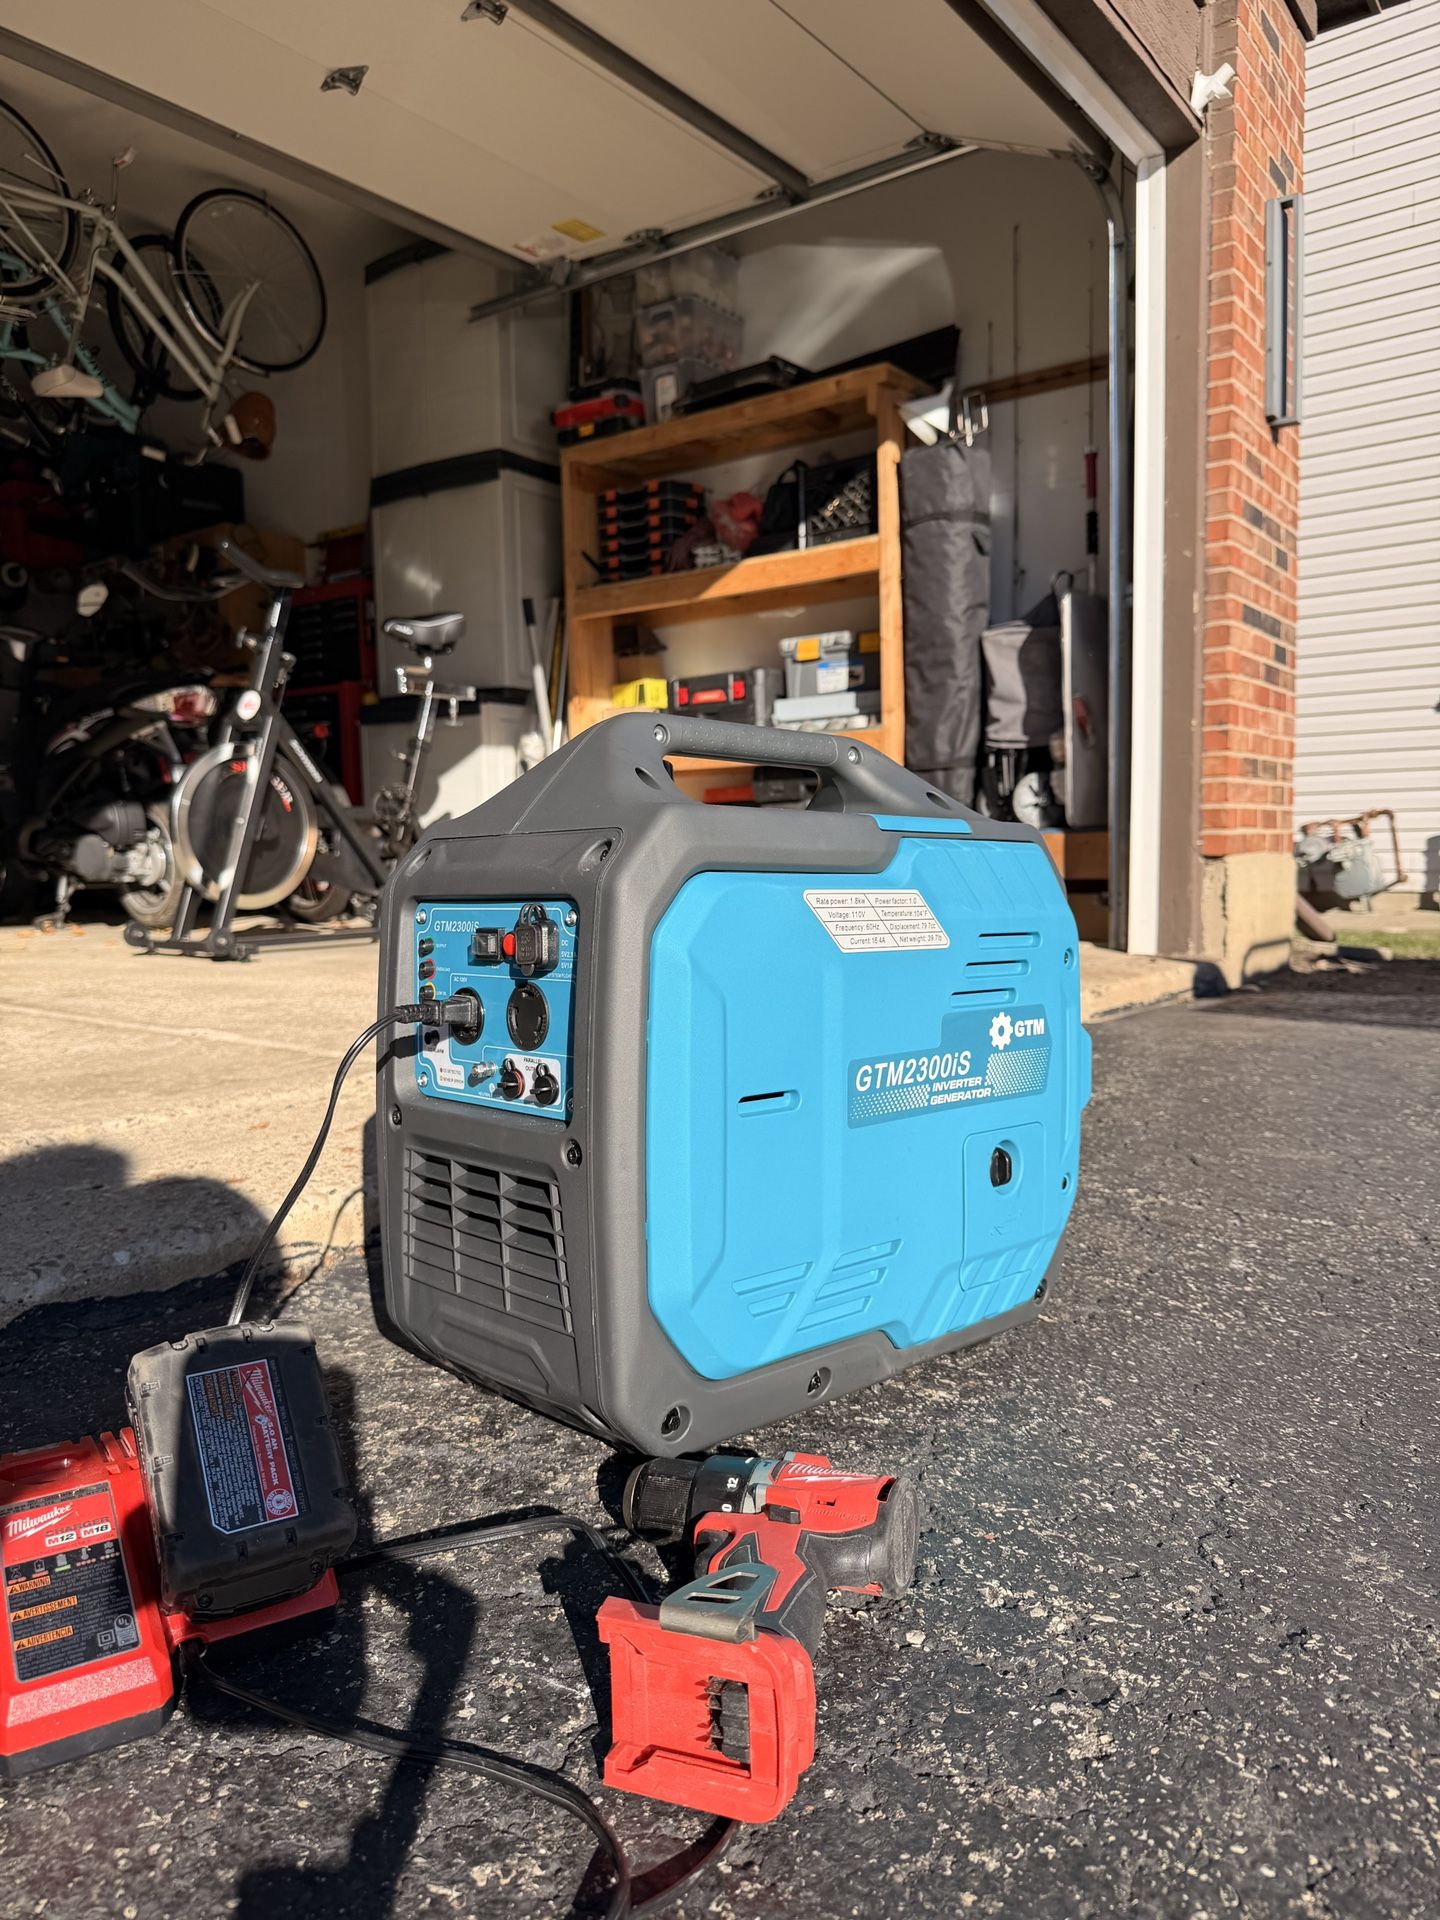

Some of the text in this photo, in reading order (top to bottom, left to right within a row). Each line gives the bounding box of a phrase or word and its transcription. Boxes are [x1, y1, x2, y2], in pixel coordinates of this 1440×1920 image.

[434, 921, 480, 933] GTM2300iS
[1014, 1018, 1045, 1038] GTM
[855, 1051, 971, 1092] GTM2300iS
[932, 1076, 982, 1092] INVERTER
[930, 1088, 991, 1105] GENERATOR
[247, 1367, 275, 1414] Milwaukee
[270, 1436, 278, 1449] AH
[268, 1461, 279, 1485] PACK
[726, 1477, 739, 1489] 12
[4, 1503, 72, 1537] Milwaukee
[47, 1532, 75, 1546] M12
[18, 1576, 50, 1592] WARNING
[23, 1596, 77, 1616] AVERTISSEMENT
[27, 1626, 72, 1646] ADVERTENCIA
